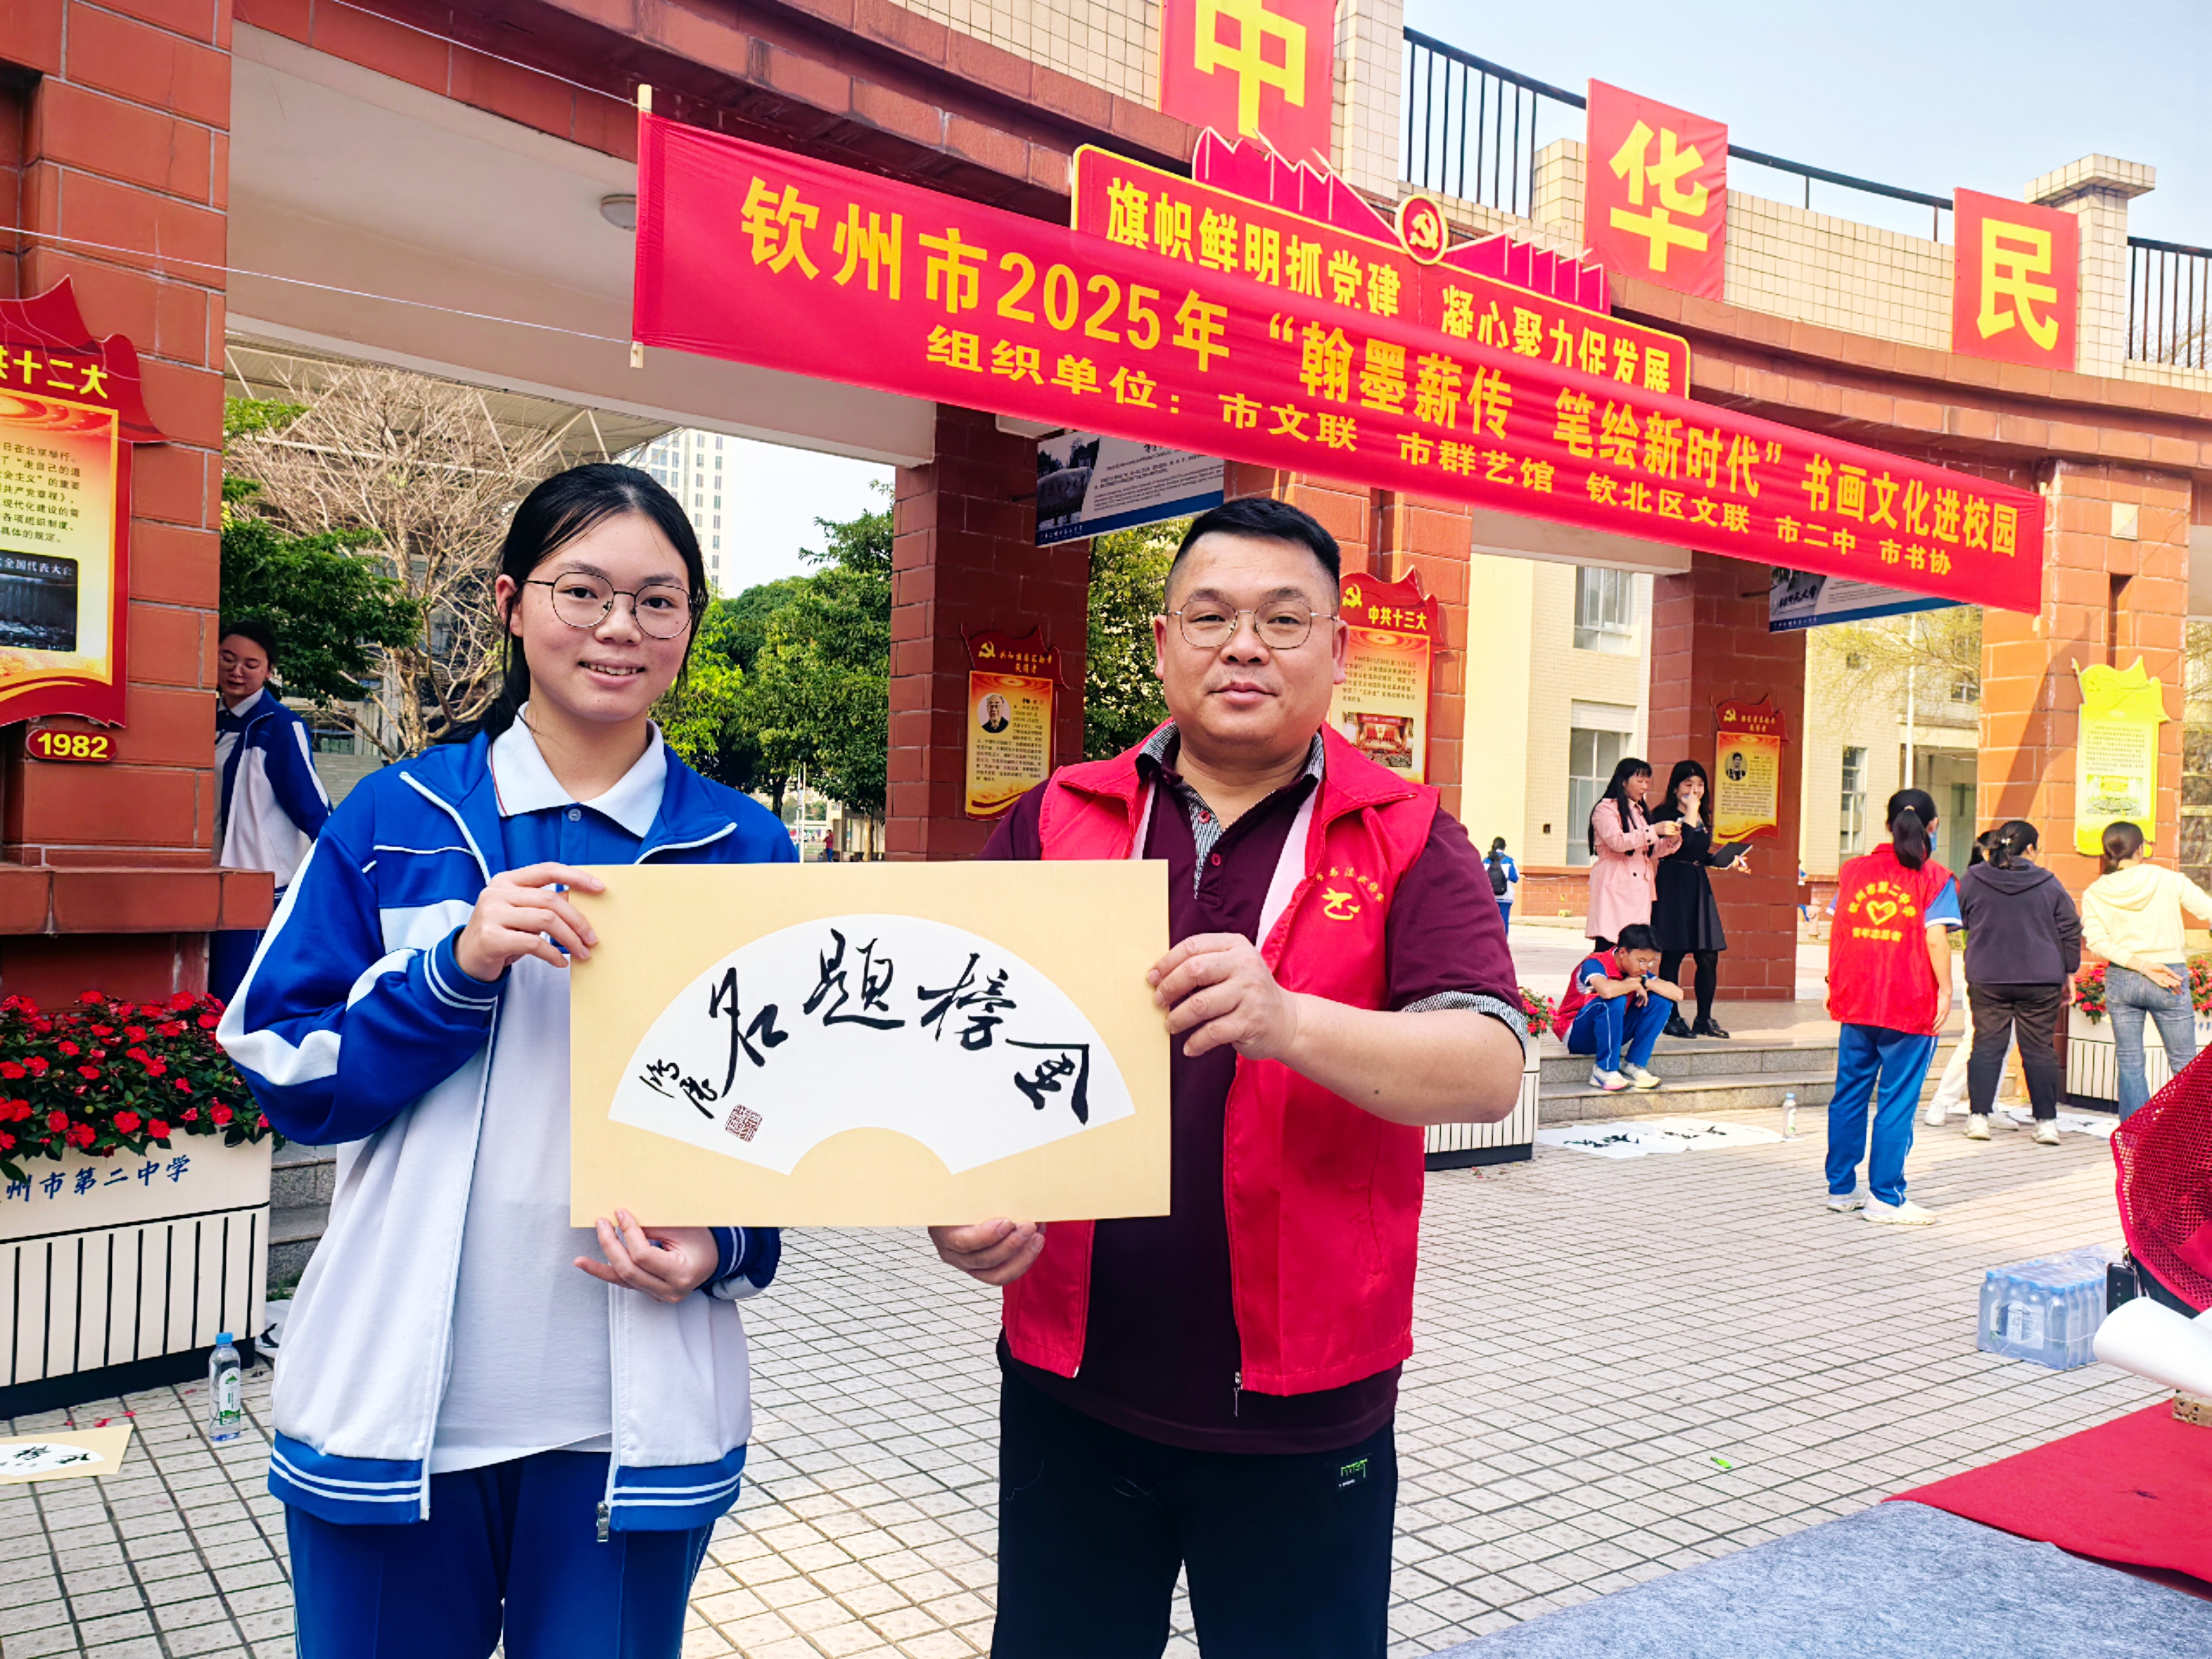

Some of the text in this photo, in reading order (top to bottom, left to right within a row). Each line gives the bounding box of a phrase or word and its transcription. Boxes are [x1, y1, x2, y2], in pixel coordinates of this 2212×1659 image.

[1195, 0, 1307, 139] 中
[1609, 120, 1710, 273] 华
[1106, 177, 1671, 394] 旗帜鲜明抓党建 凝心聚力促发展
[1976, 217, 2060, 352] 民
[0, 469, 80, 491] 会主义”的重要
[0, 483, 74, 504] 共产党章程》，
[1397, 433, 1555, 493] 市群艺馆
[1586, 472, 1750, 534] 钦北区文联
[1776, 515, 1856, 555] 市二中
[1879, 538, 1952, 576] 市书协
[1368, 605, 1427, 631] 中共十三大
[38, 733, 109, 759] 1982
